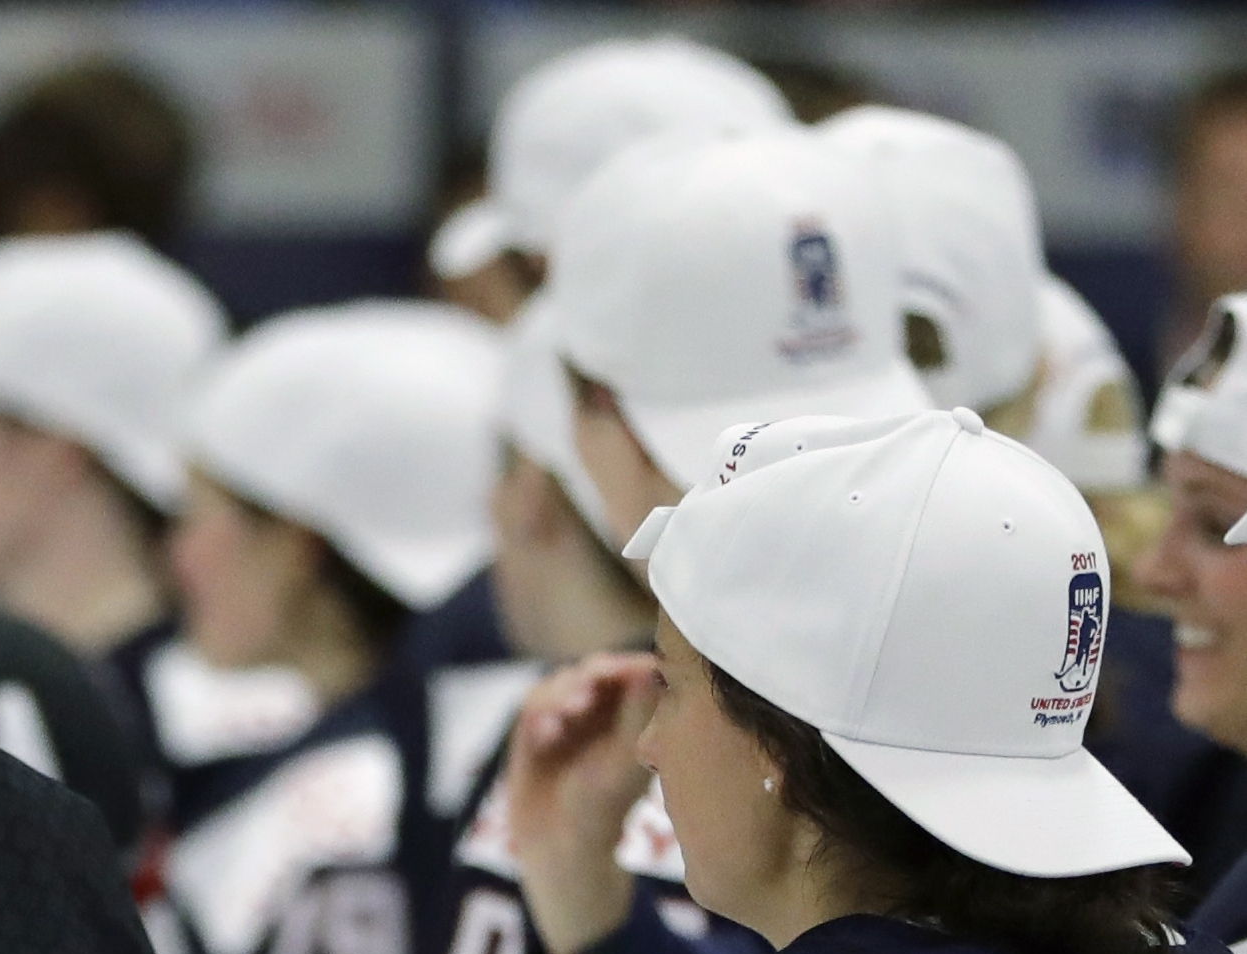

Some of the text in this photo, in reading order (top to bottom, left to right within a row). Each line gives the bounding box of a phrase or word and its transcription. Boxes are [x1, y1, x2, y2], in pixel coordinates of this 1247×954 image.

[1071, 551, 1097, 571] 2017
[1074, 586, 1101, 606] IIHF
[1030, 697, 1070, 711] UNITED
